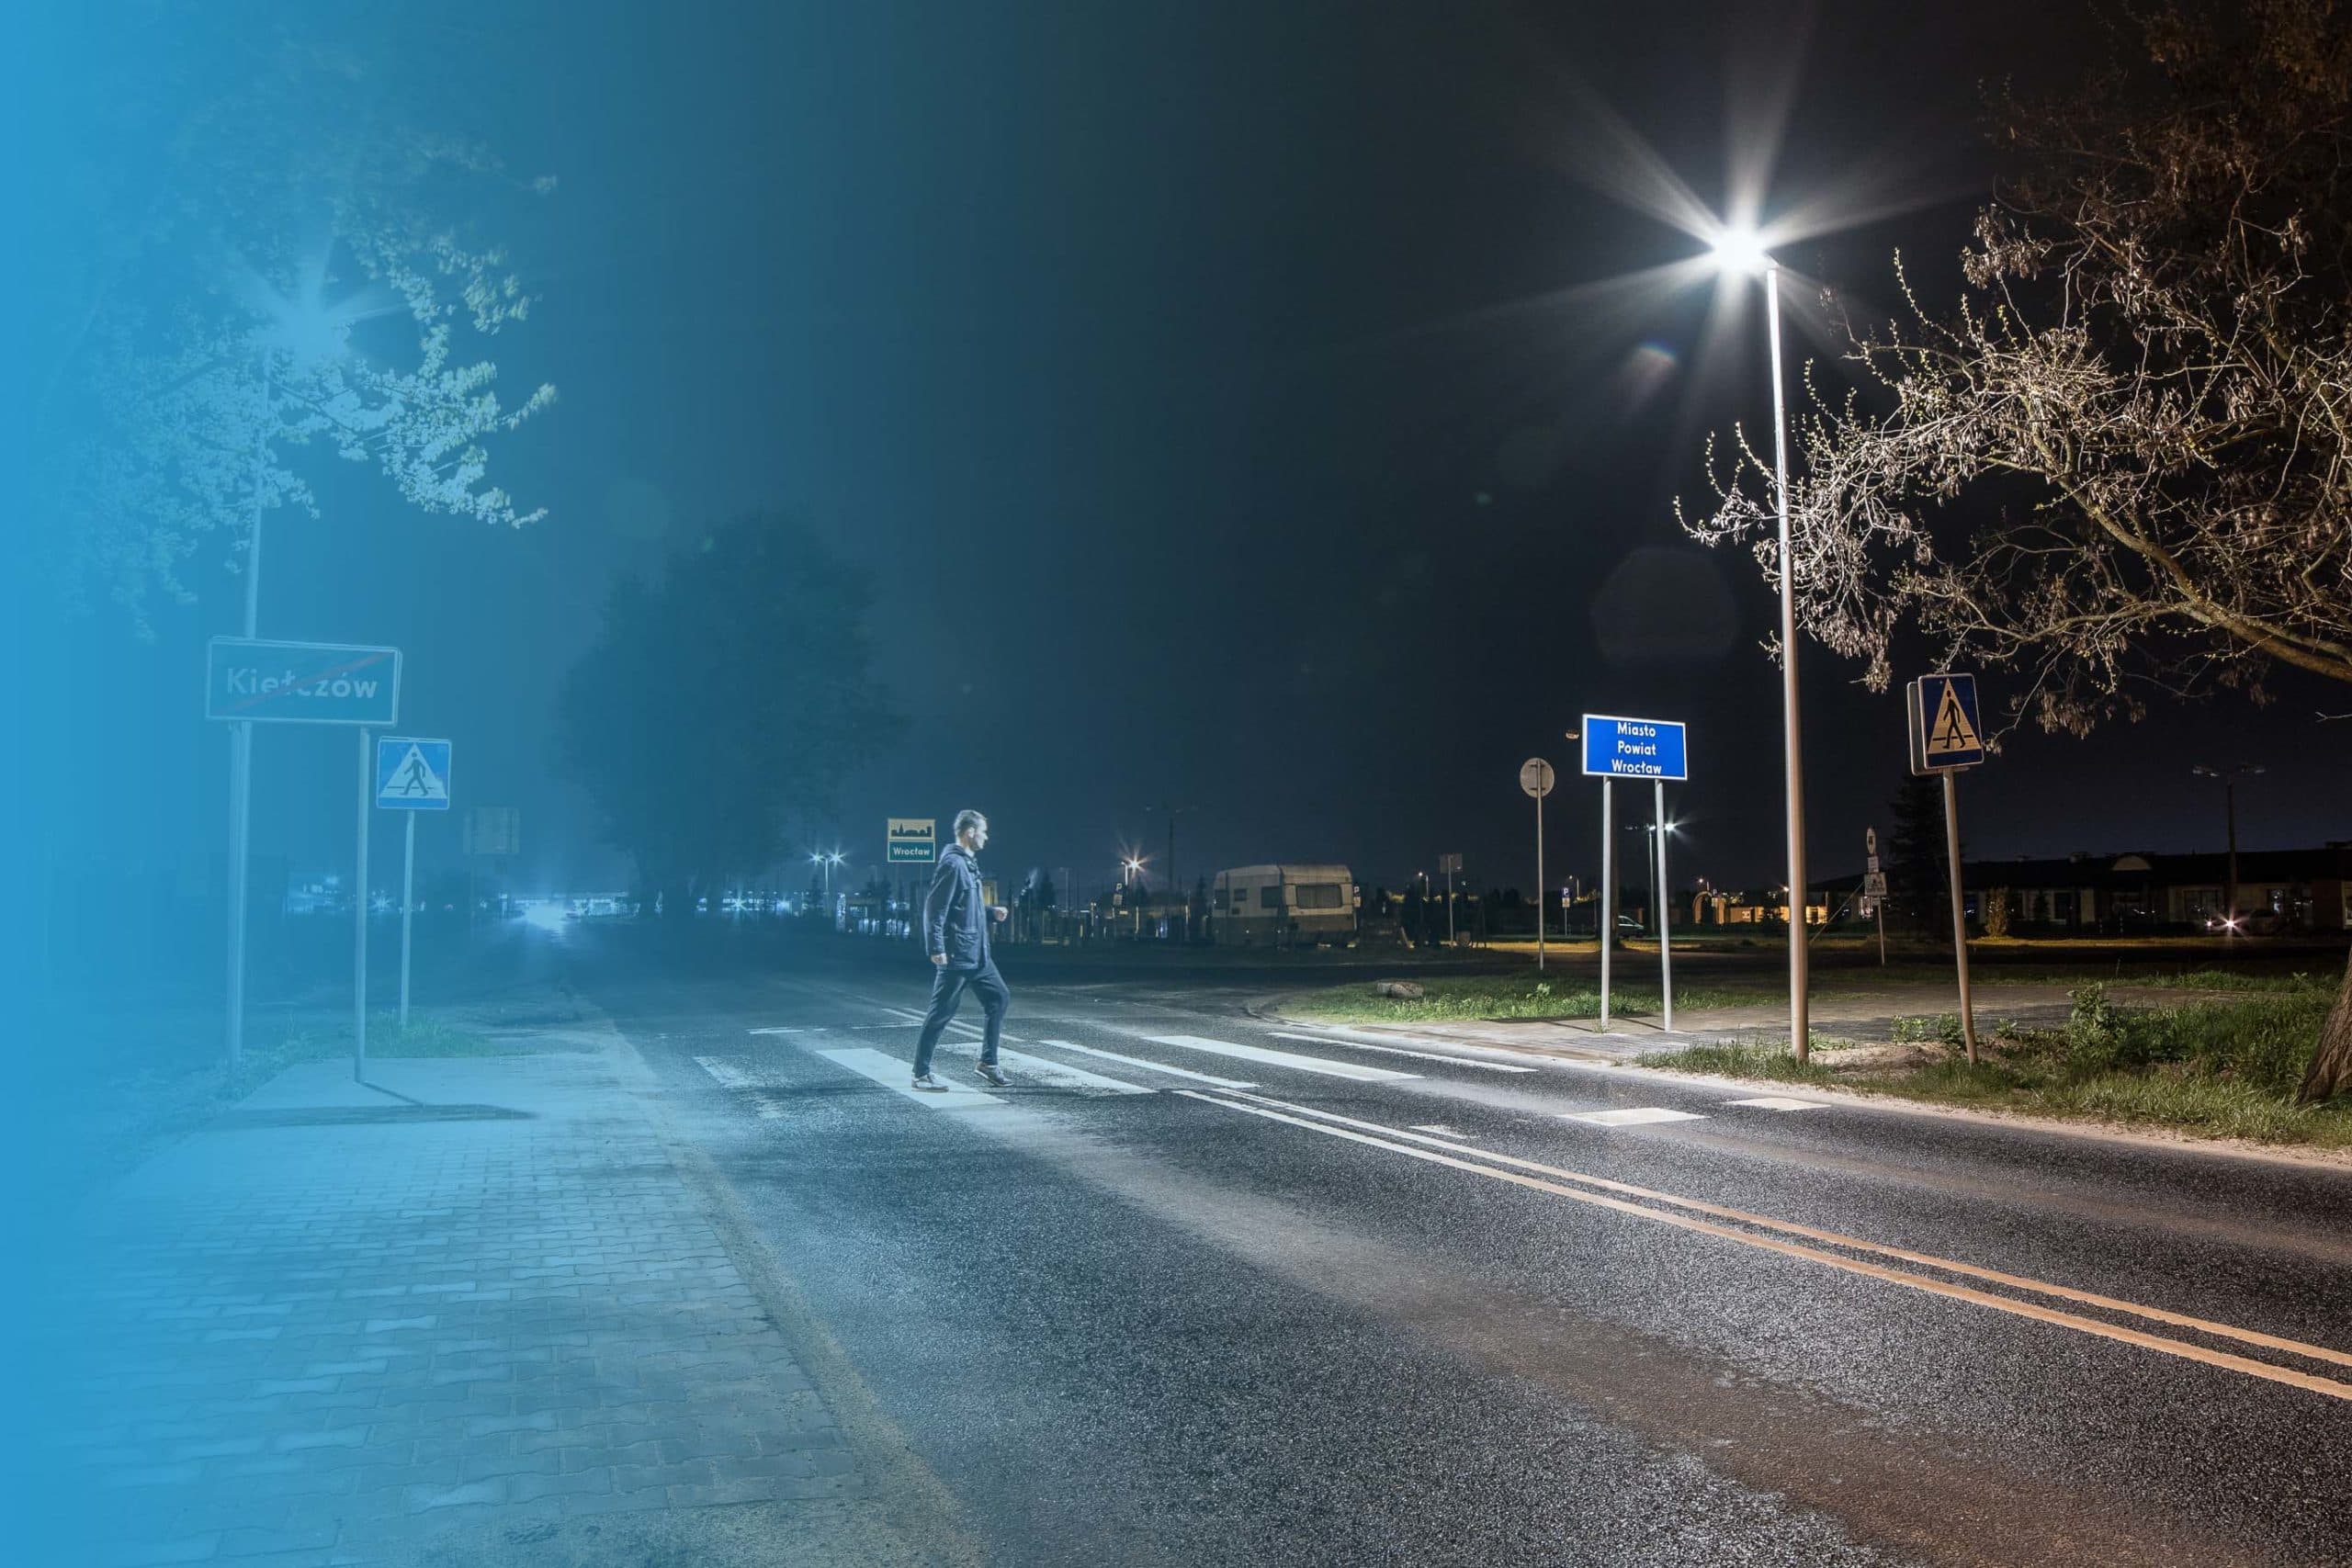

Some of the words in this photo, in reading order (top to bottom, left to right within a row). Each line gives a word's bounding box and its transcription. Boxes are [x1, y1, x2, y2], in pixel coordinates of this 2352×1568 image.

[1617, 721, 1657, 738] Miasto
[1617, 740, 1657, 755] Powiat
[1611, 759, 1662, 774] Wrocław
[893, 846, 931, 855] Wrocław
